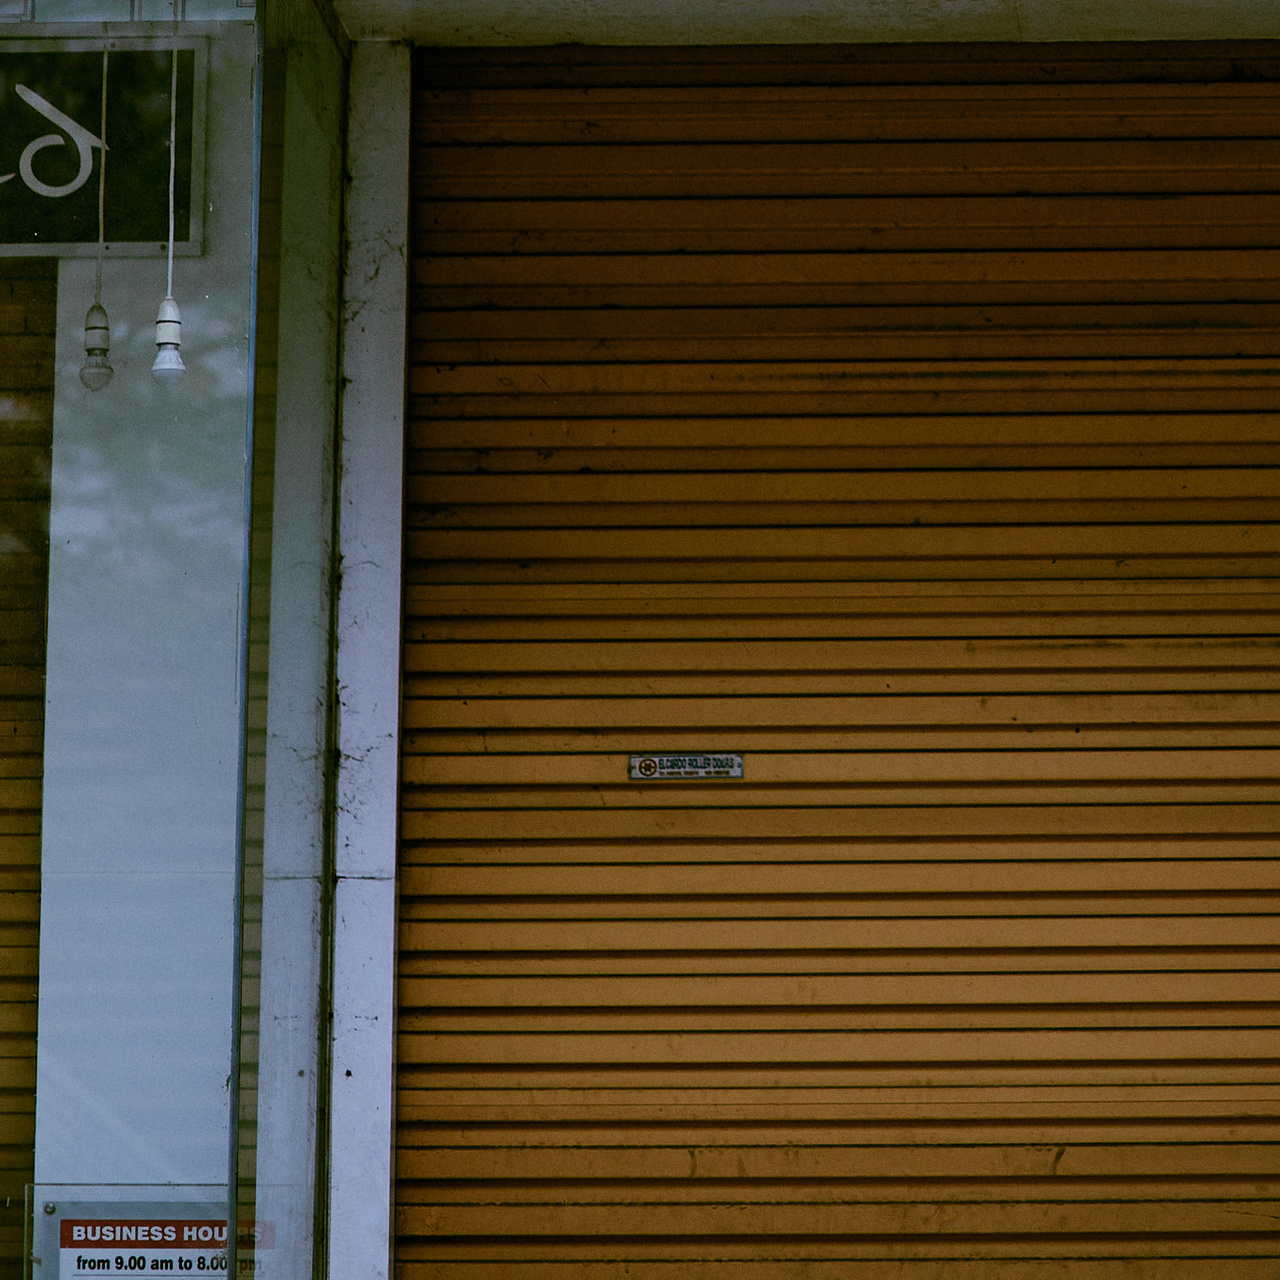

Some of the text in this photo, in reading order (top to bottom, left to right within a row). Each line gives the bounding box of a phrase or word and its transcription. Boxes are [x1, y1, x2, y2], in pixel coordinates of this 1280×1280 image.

[72, 1225, 177, 1242] BUSINESS
[76, 1255, 111, 1271] from
[114, 1255, 147, 1271] 9.00
[150, 1259, 174, 1271] am
[178, 1257, 193, 1271] to
